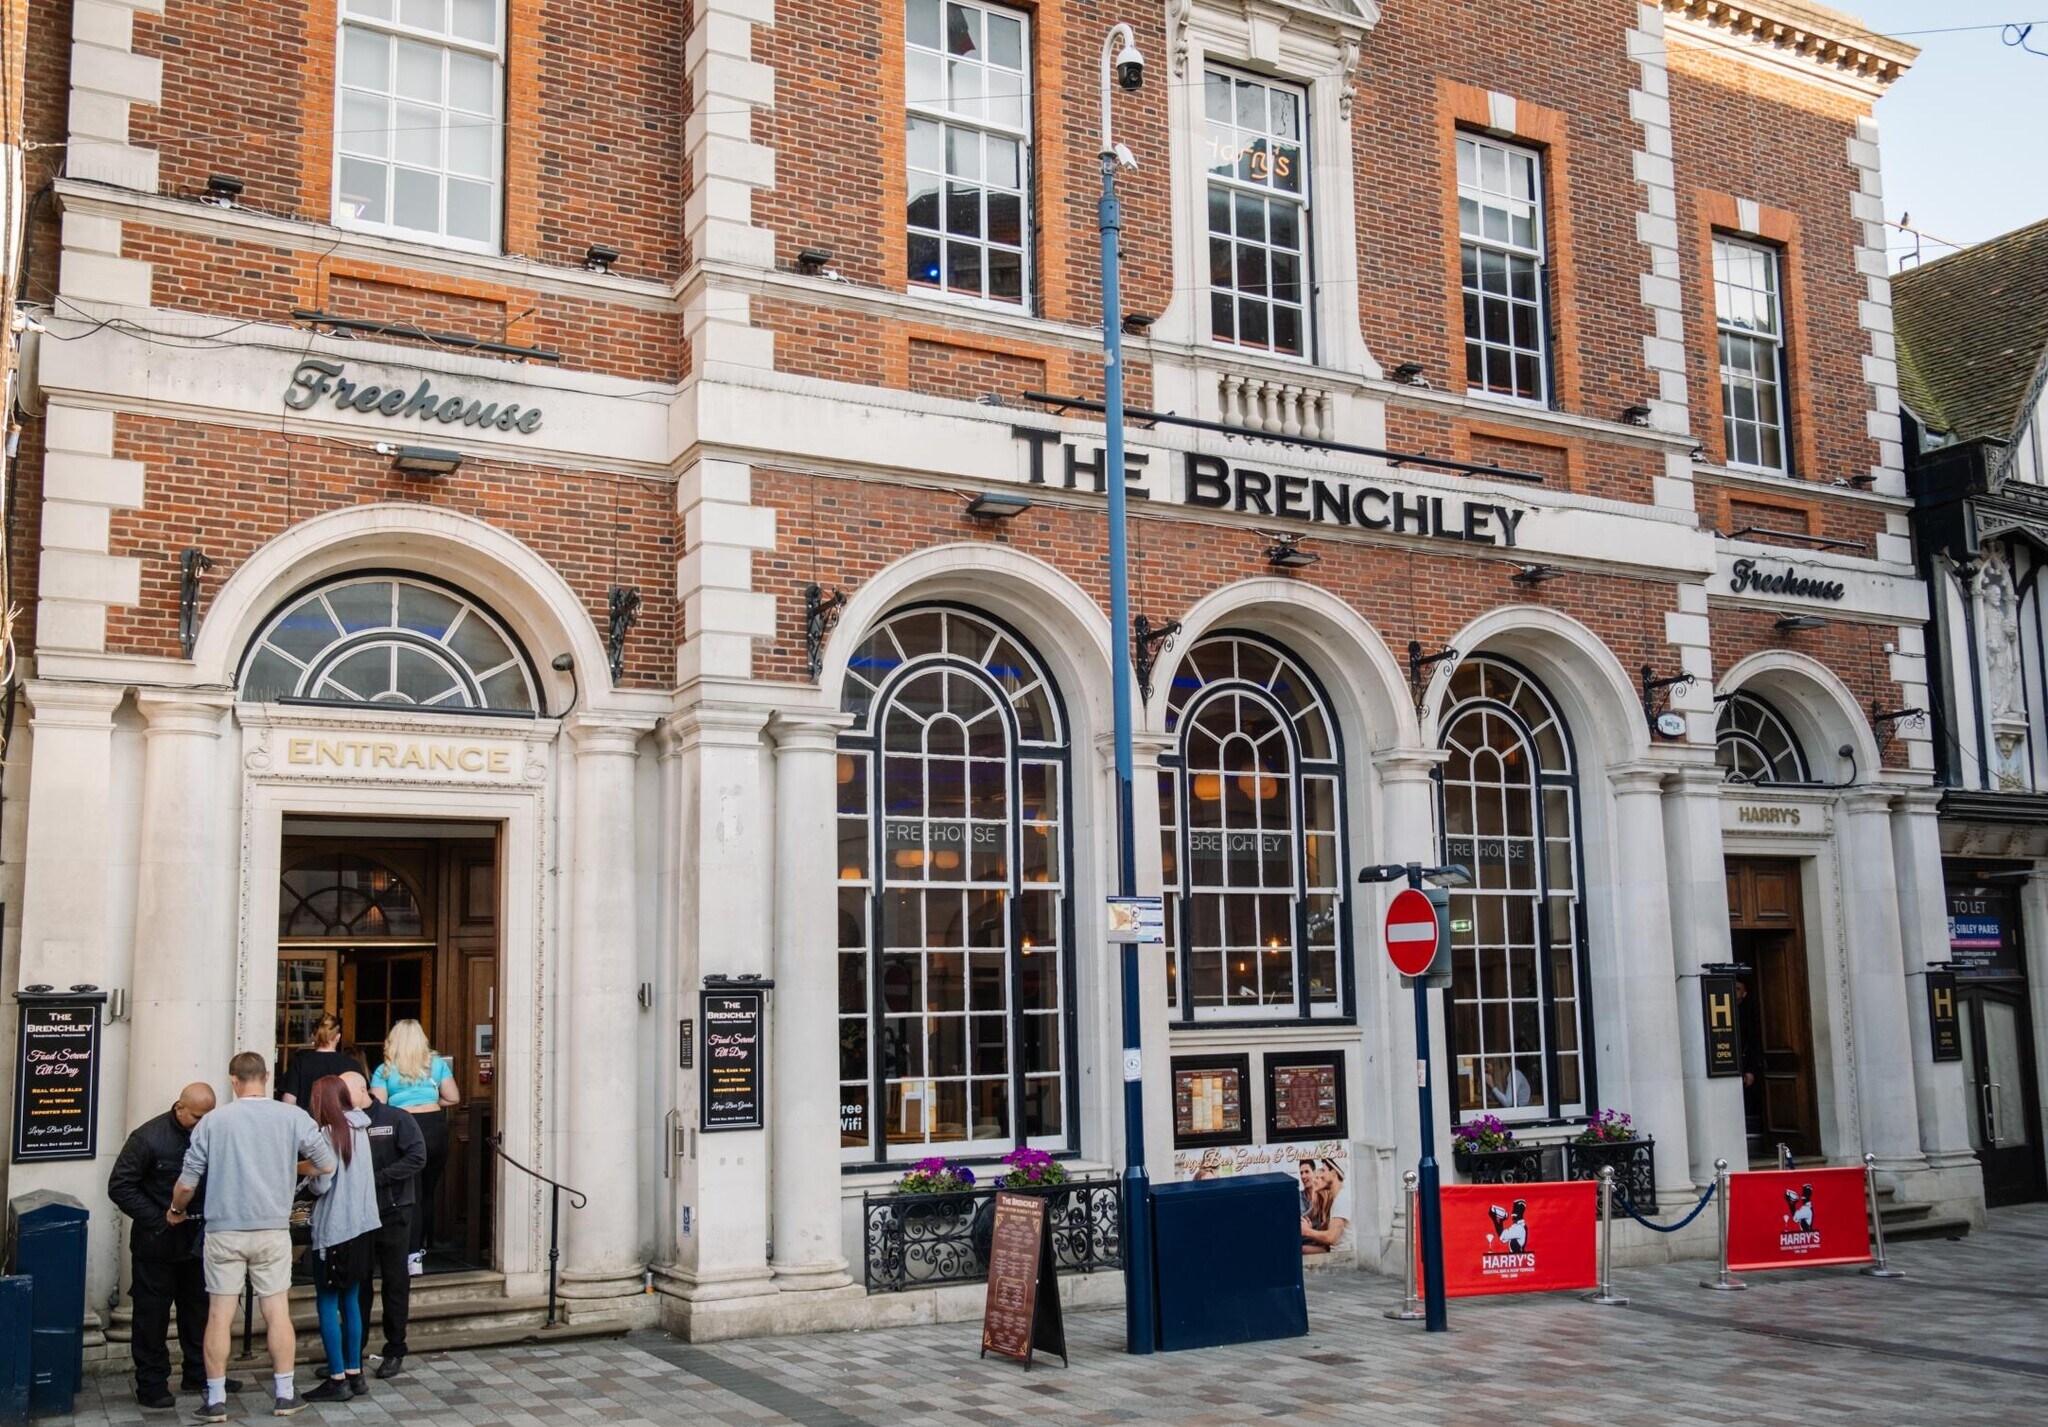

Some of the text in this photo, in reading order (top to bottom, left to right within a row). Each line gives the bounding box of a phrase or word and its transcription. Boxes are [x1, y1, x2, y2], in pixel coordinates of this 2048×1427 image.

[284, 359, 543, 434] Freehouse
[1011, 423, 1525, 546] THE BRENCHLEY
[1730, 559, 1845, 601] Freehouse
[288, 737, 512, 773] ENTRANCE
[1738, 806, 1801, 825] HARRY'S
[1953, 900, 1986, 914] TO LET
[1956, 924, 1977, 934] SIBLEY
[1978, 924, 1999, 934] PARES
[723, 1001, 741, 1009] THE
[1934, 987, 1953, 1018] H
[49, 1012, 72, 1021] THE
[707, 1011, 757, 1020] BRENCHLEY
[1710, 993, 1732, 1027] H
[27, 1024, 93, 1033] BRENCHLEY
[27, 1049, 58, 1062] Food
[1716, 1050, 1732, 1059] OPEN
[841, 1104, 863, 1115] ree
[1780, 1231, 1820, 1245] HARRY'S
[1483, 1254, 1535, 1268] HARRY'S
